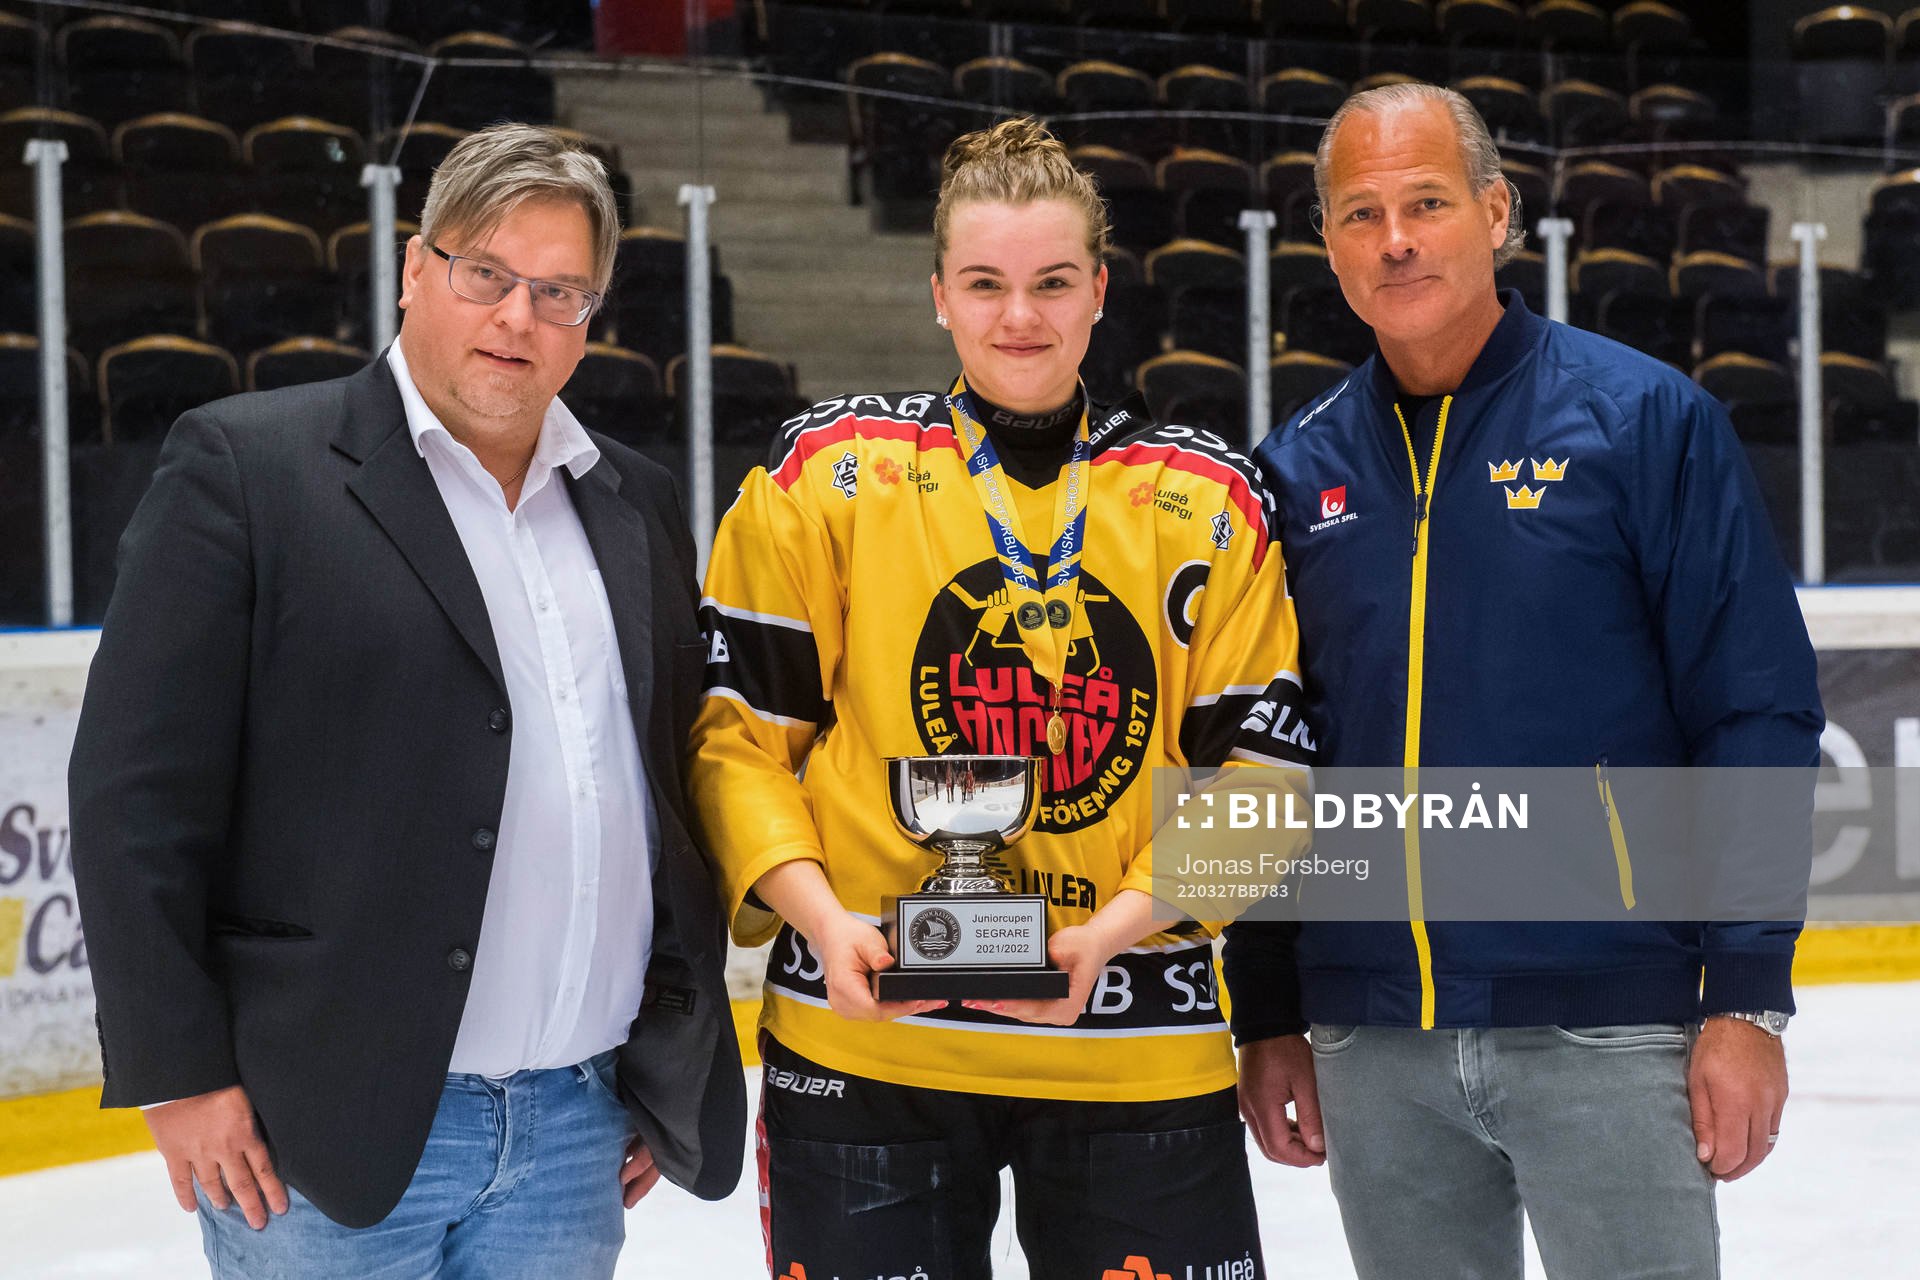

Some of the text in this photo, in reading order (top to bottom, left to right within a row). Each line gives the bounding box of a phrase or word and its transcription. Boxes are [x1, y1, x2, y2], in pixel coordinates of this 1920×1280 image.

[1089, 410, 1132, 446] AUER
[1154, 499, 1193, 520] nergi
[1310, 512, 1359, 533] SVENSKA SPEL
[1058, 521, 1076, 587] SVENSKA
[950, 653, 1120, 719] LULEÅ
[920, 666, 958, 753] LULEÅ
[1125, 687, 1151, 748] 1977
[972, 914, 1033, 925] Juniorcupen
[975, 929, 1030, 938] SEGRARE
[976, 944, 1030, 954] 2021/2022
[767, 1066, 845, 1098] BAUER
